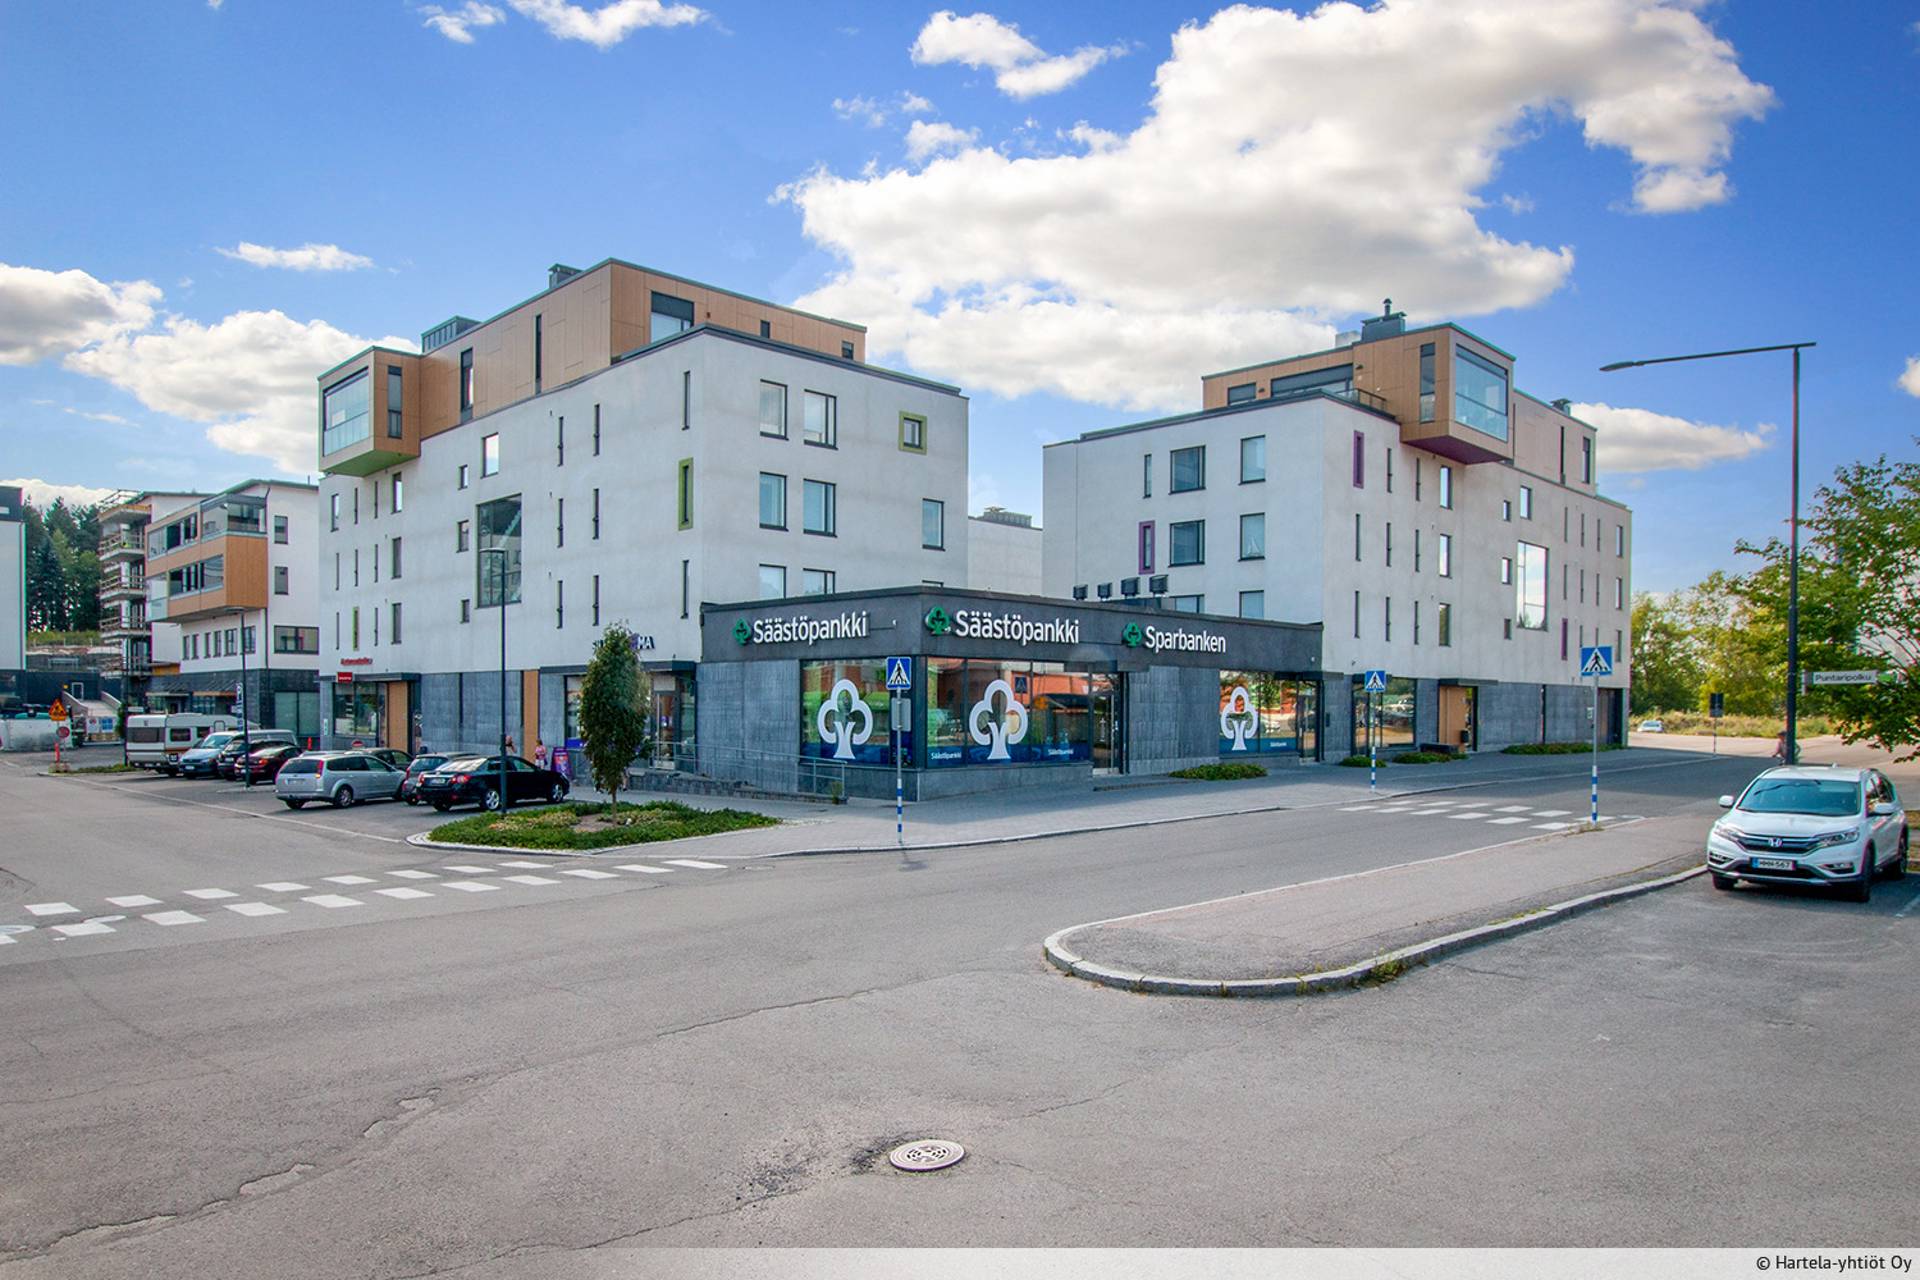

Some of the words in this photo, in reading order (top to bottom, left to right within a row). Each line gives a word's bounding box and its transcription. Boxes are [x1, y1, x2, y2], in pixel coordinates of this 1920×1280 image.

[753, 610, 867, 646] Säästöpankki
[955, 610, 1080, 646] Säästöpankki
[1145, 625, 1227, 653] Sparbanken
[1814, 673, 1872, 682] Puntaripolku
